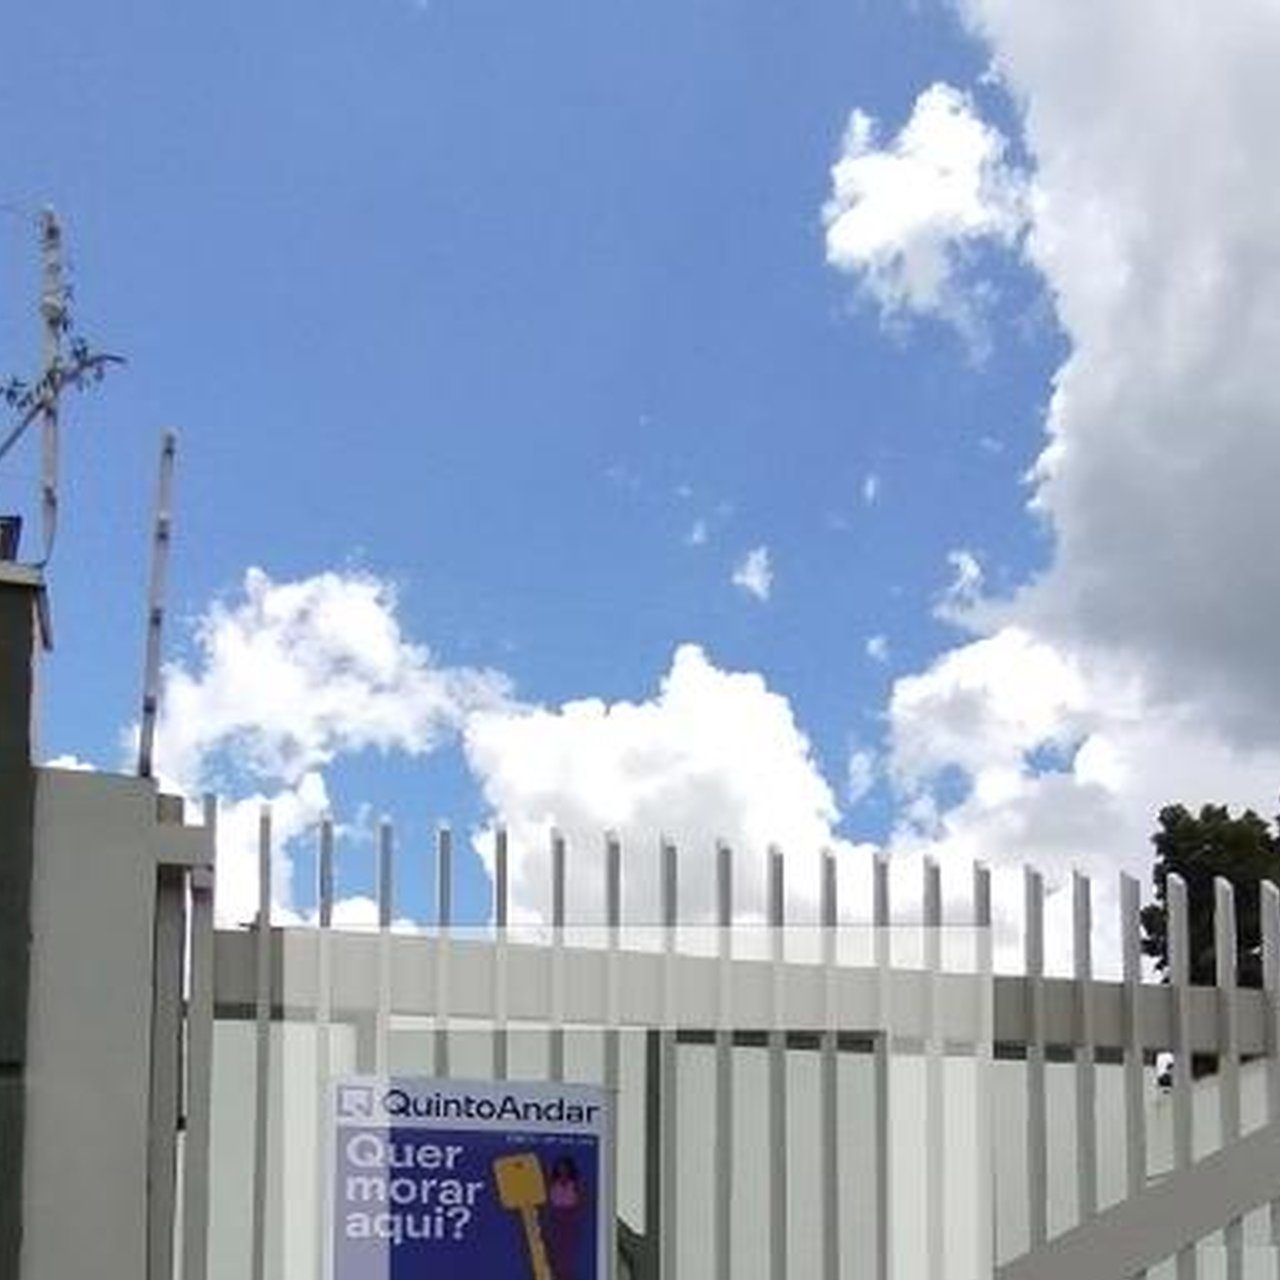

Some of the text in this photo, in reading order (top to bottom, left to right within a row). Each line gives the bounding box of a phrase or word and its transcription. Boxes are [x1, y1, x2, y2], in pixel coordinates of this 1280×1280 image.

[381, 1089, 600, 1124] QuintoAndar
[345, 1133, 463, 1170] Quer
[344, 1174, 485, 1206] morar
[345, 1207, 472, 1245] aqui?
